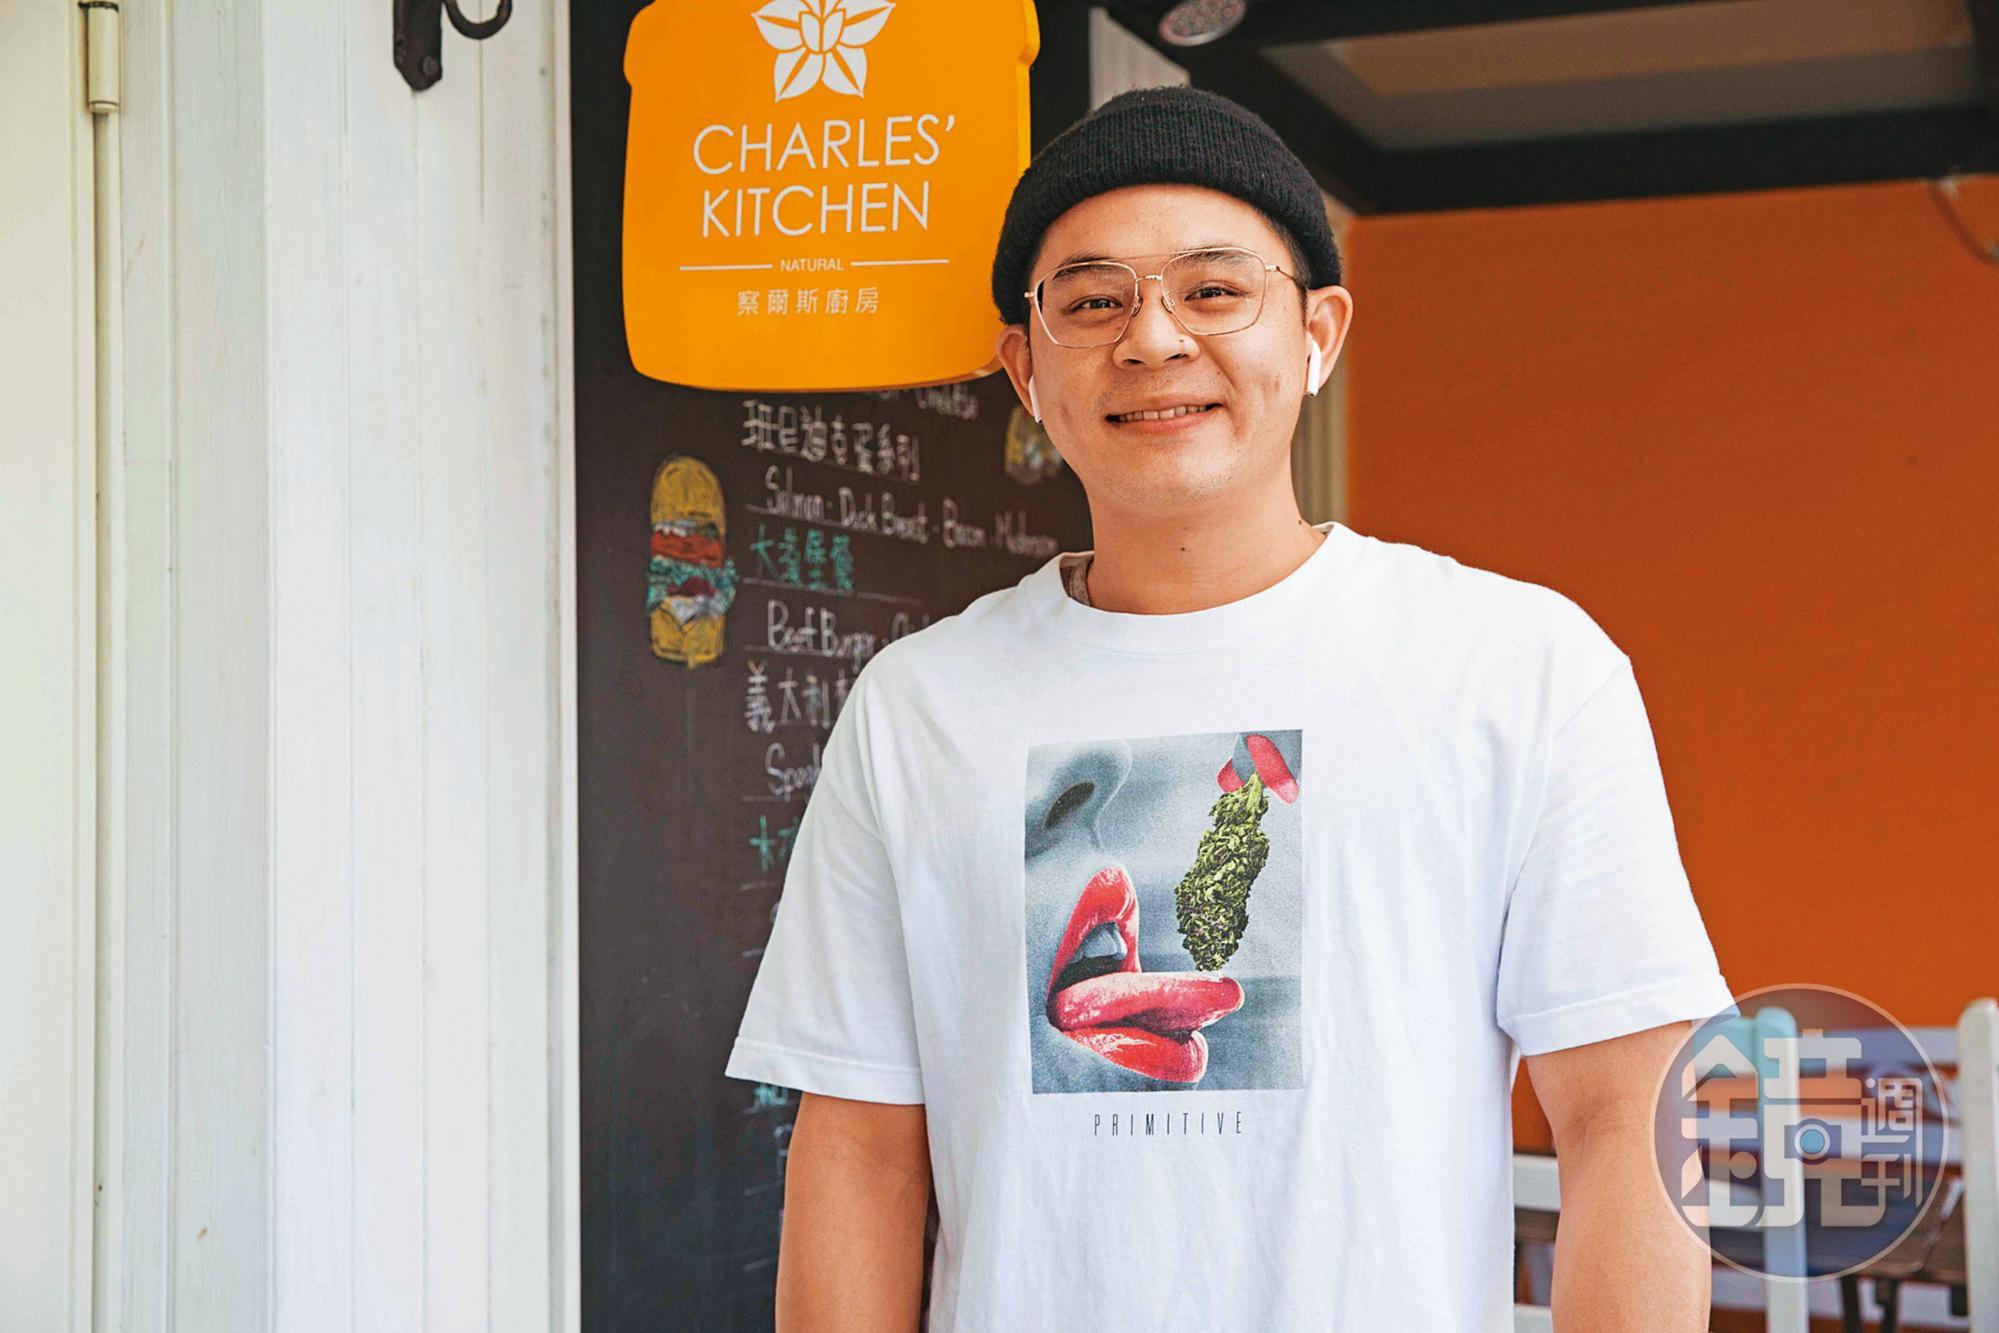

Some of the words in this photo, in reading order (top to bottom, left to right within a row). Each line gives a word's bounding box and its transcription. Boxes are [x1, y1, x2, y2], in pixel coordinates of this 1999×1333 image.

[702, 181, 929, 238] KITCHEN
[780, 258, 844, 272] NATURAL
[737, 287, 880, 317] 察爾斯廚房
[1094, 1111, 1243, 1137] PRIMITIVE
